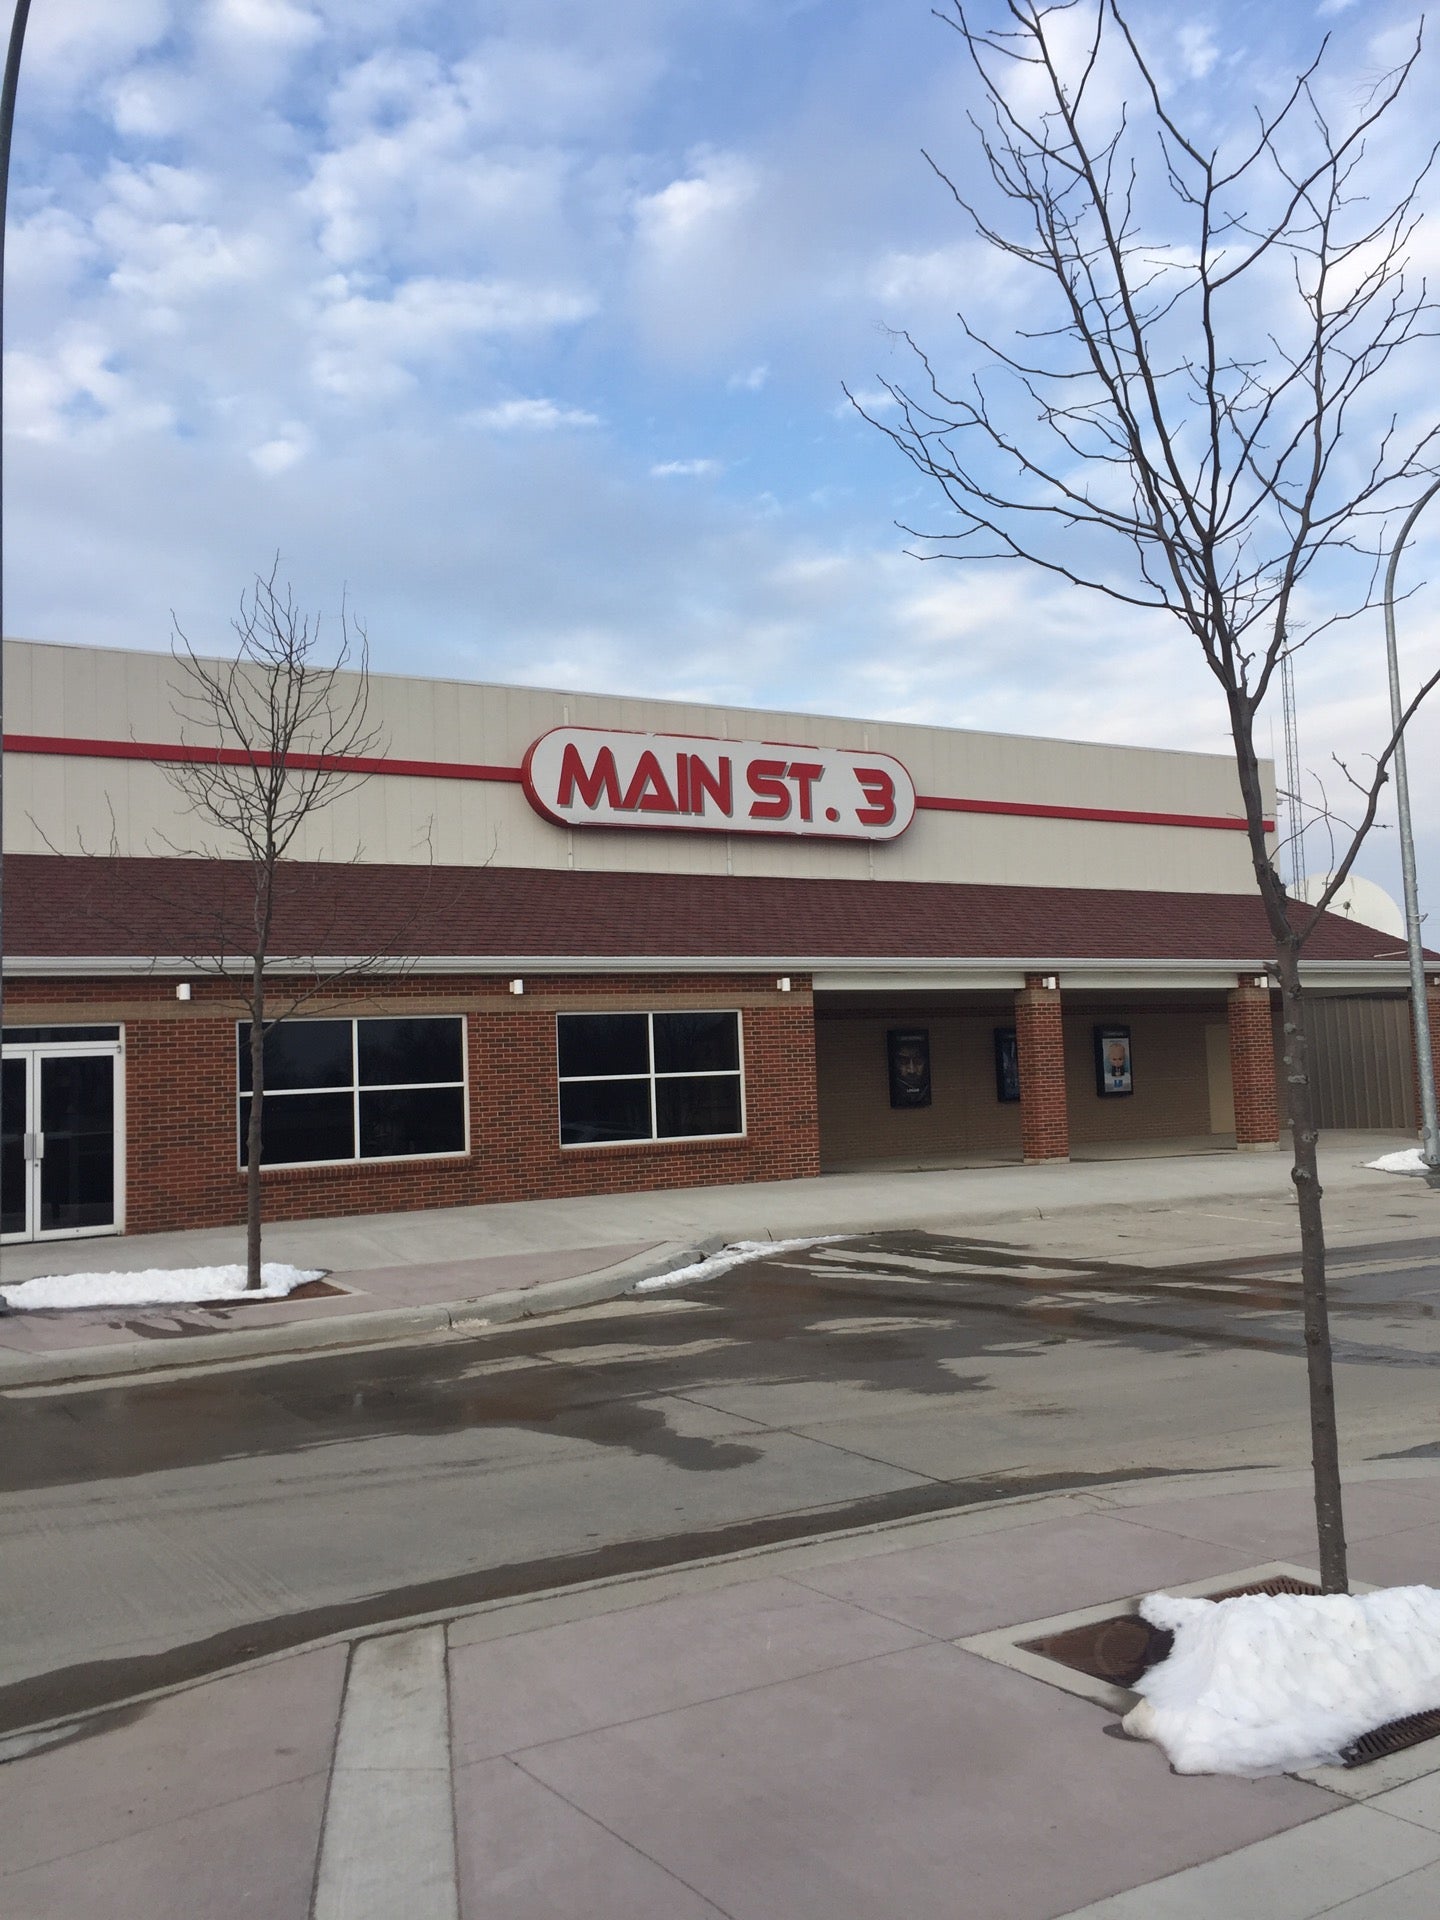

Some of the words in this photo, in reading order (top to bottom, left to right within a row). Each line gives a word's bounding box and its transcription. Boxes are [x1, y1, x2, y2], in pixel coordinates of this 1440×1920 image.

[557, 743, 732, 817] MAIN
[746, 759, 839, 823] ST.
[853, 767, 895, 826] 3
